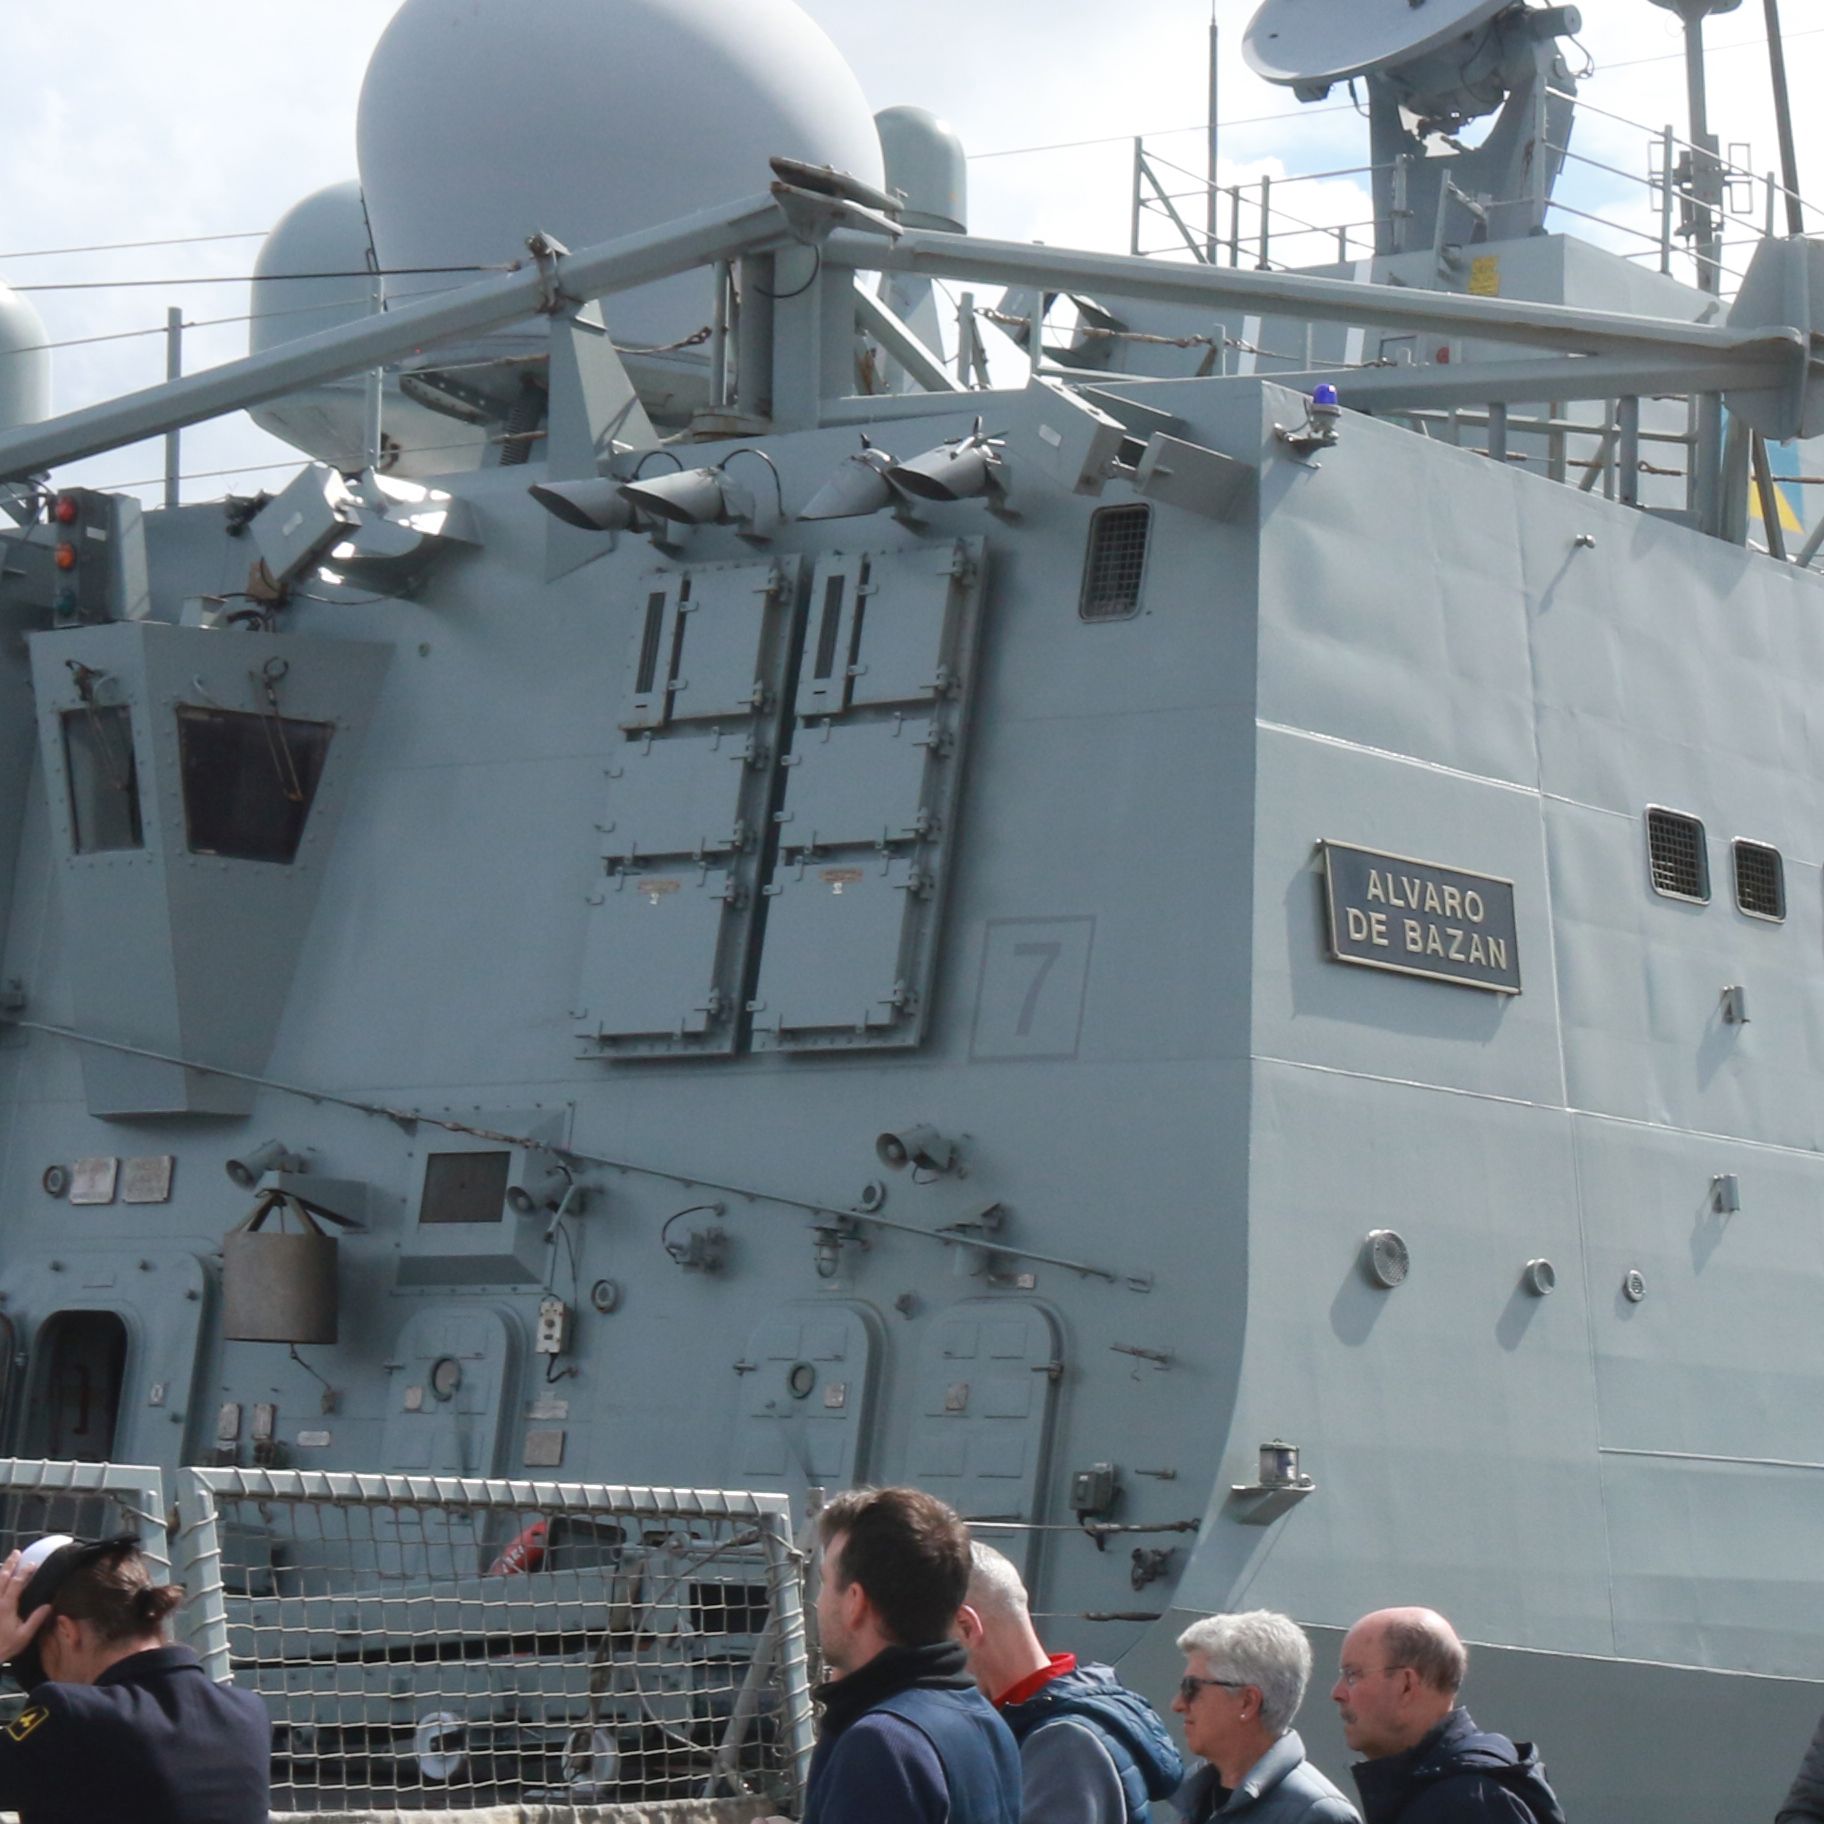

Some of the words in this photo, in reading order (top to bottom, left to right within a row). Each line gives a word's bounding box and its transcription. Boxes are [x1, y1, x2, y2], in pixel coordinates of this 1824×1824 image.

[1367, 869, 1485, 923] ALVARO
[1346, 907, 1390, 946] DE
[1404, 918, 1507, 970] BAZAN
[1014, 942, 1061, 1037] 7
